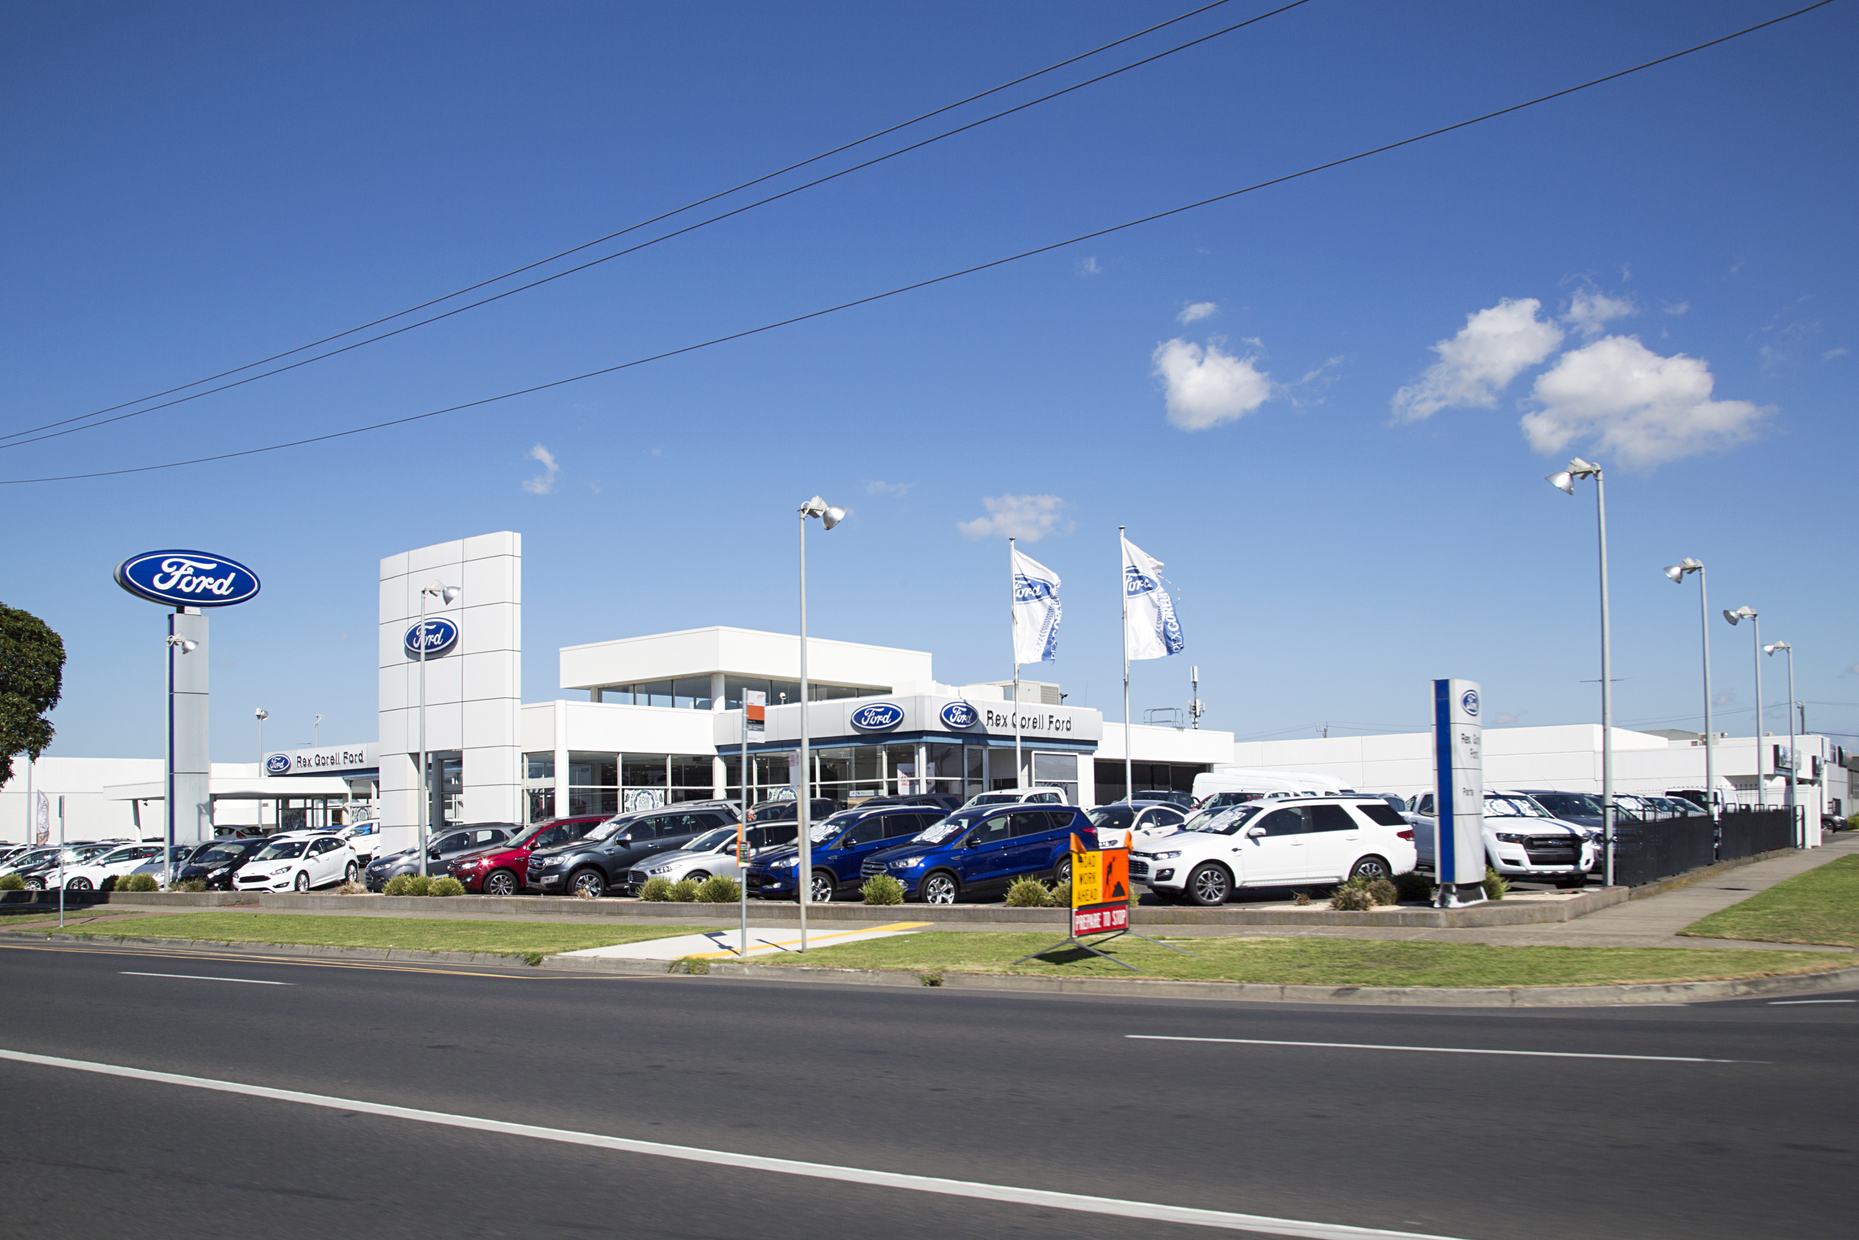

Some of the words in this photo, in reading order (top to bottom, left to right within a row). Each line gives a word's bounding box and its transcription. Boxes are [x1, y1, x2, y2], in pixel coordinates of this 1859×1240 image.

[153, 557, 236, 596] Ford
[861, 707, 893, 726] Ford
[949, 706, 973, 725] Ford
[986, 710, 1008, 728] Rex
[1011, 711, 1044, 730] Gorell
[1047, 714, 1072, 732] Ford
[269, 757, 285, 770] Ford
[296, 755, 313, 769] Rex
[314, 751, 341, 767] Gorell
[343, 749, 364, 765] Ford
[1079, 872, 1096, 885] WORK
[1077, 888, 1098, 902] AHEAD
[1075, 912, 1102, 931] PREPARE
[1102, 911, 1111, 927] TO
[1112, 909, 1127, 926] STOP
